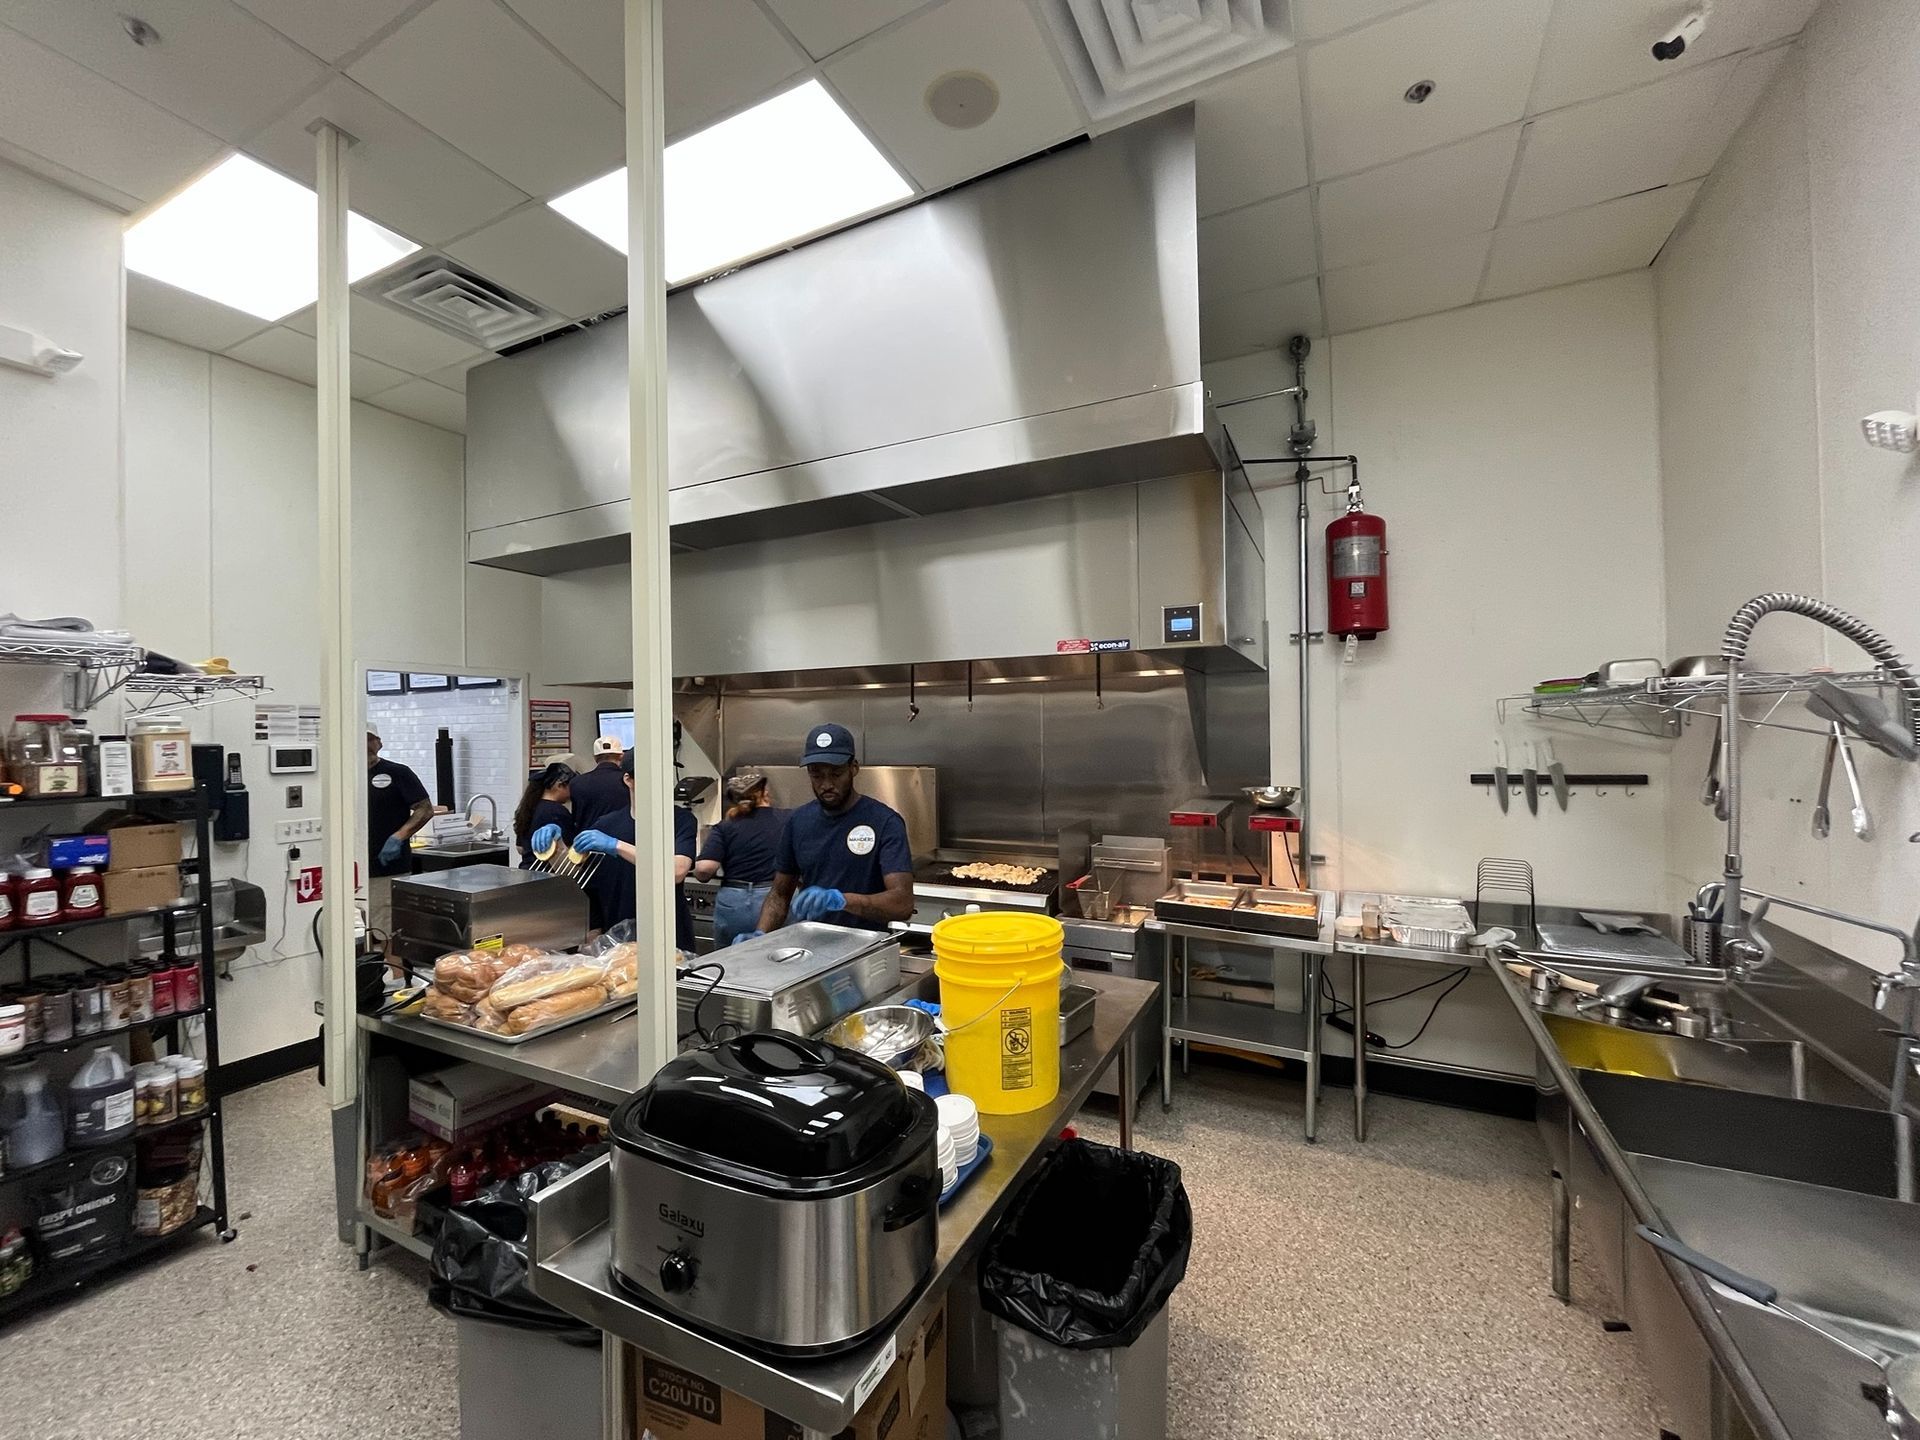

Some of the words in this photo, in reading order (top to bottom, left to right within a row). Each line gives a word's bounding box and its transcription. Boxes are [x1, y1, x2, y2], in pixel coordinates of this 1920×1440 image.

[1098, 641, 1129, 649] econ-air
[75, 1193, 117, 1214] ONIONS
[659, 1203, 704, 1238] Galaxy
[656, 1367, 689, 1387] STOCK
[648, 1377, 716, 1414] C20UTD
